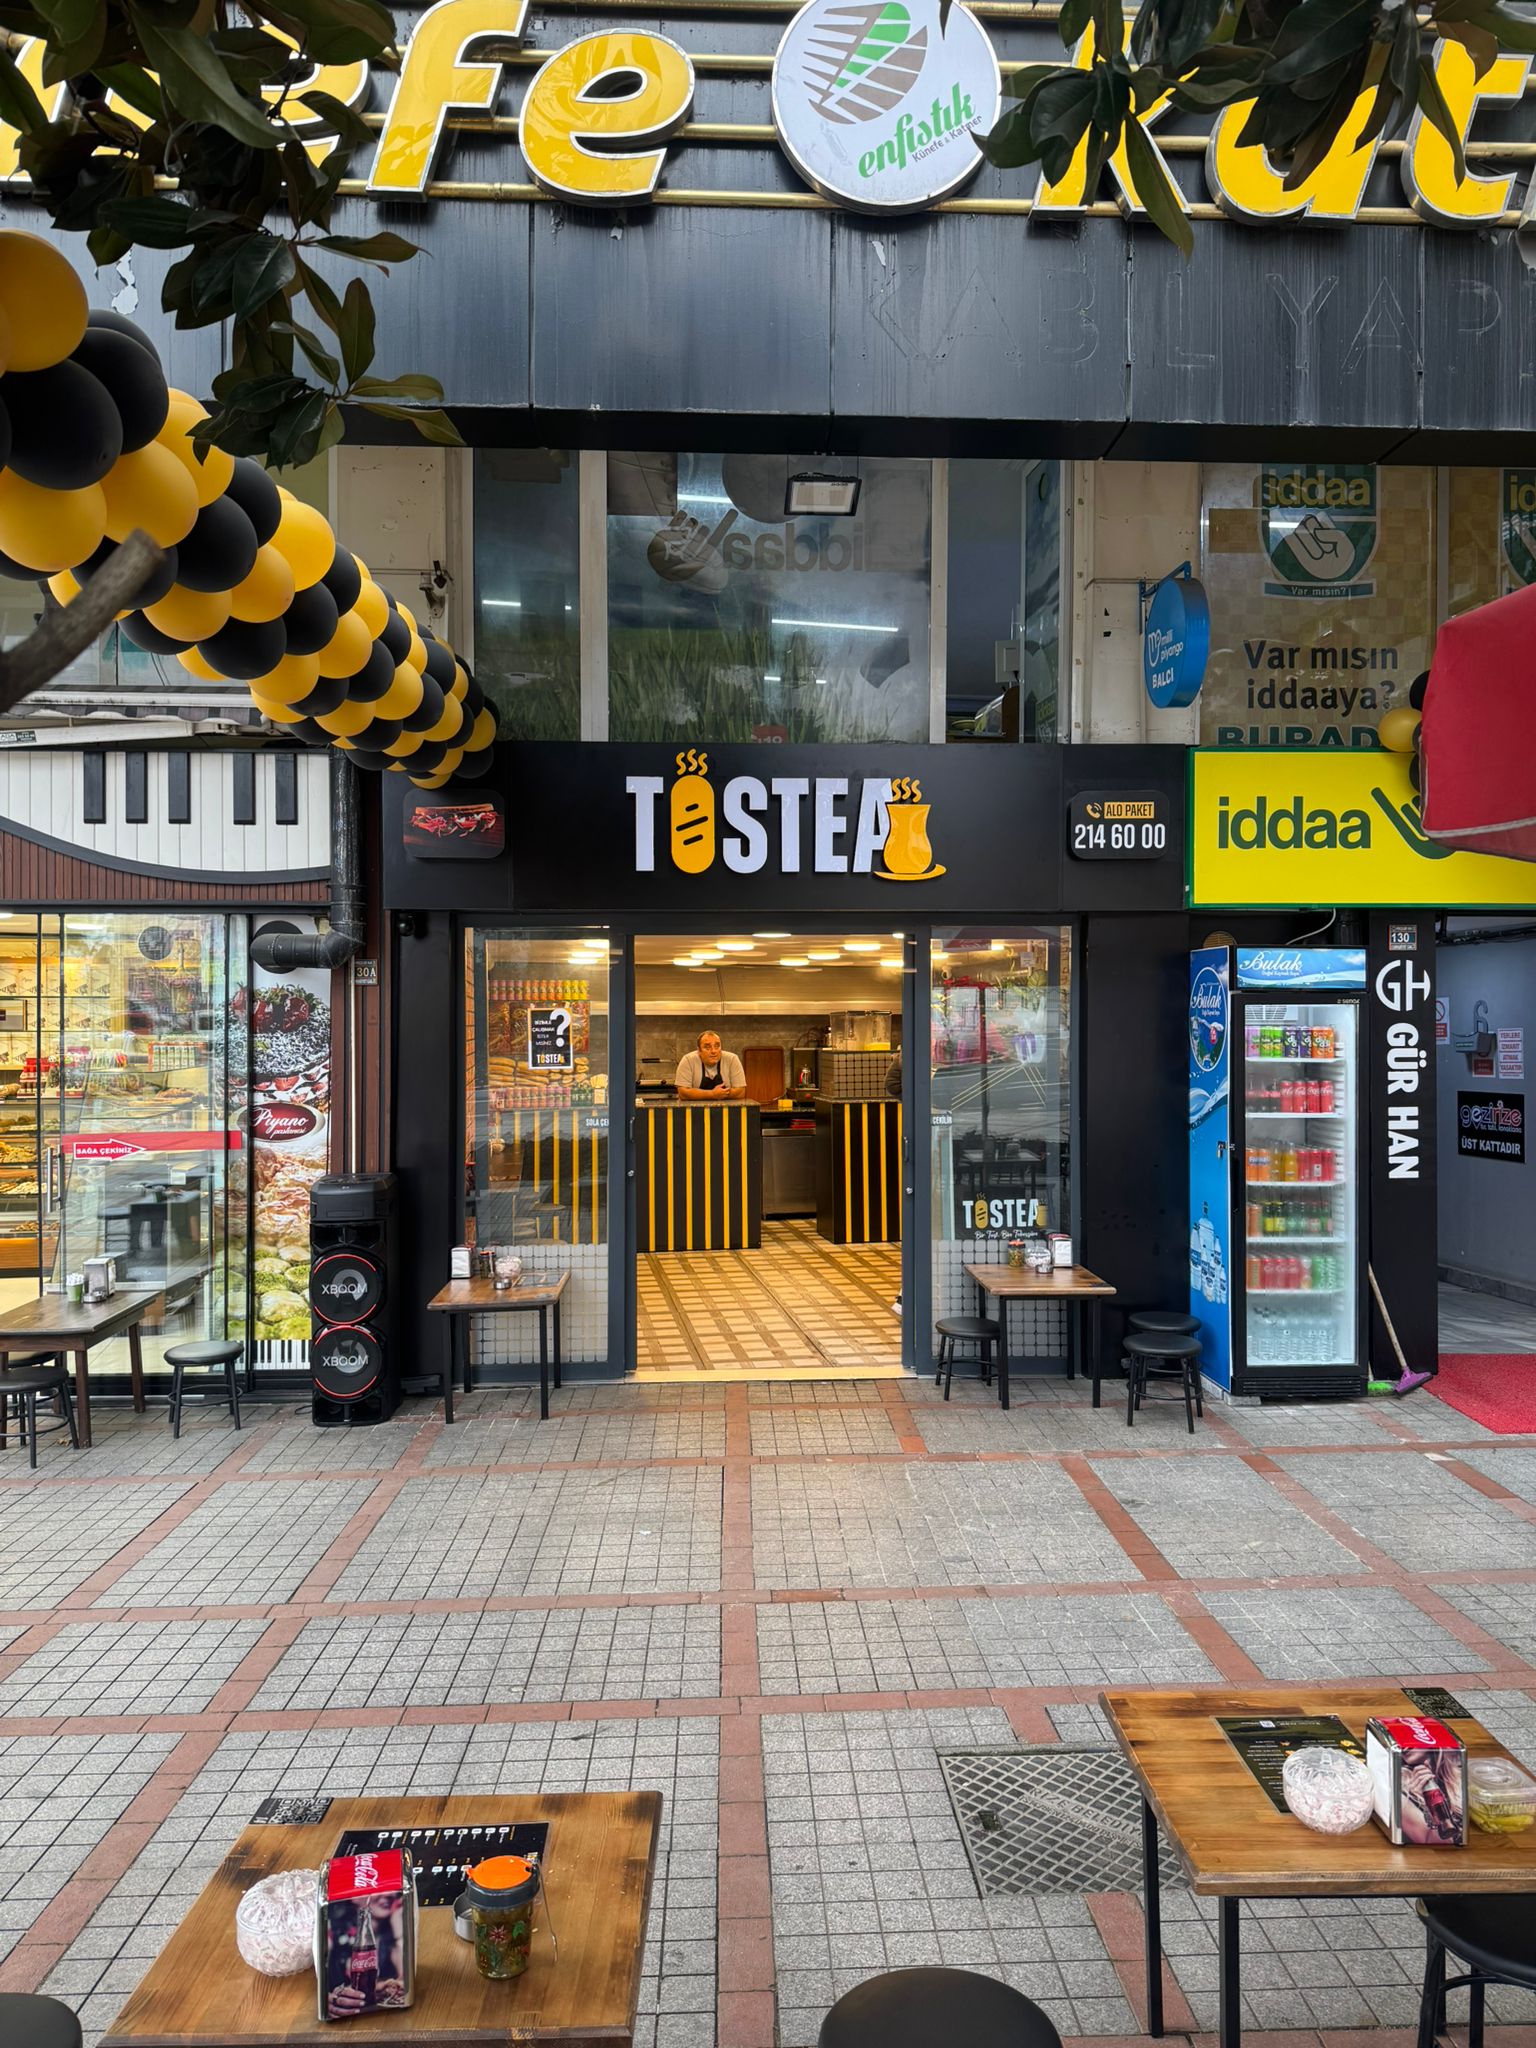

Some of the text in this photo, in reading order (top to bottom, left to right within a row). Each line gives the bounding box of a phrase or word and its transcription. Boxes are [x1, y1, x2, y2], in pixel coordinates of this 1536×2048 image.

[1244, 640, 1300, 669] Var
[1247, 678, 1396, 717] iddaaya?
[1106, 804, 1152, 816] ALO PAKET
[1218, 796, 1372, 849] iddaa
[1074, 823, 1166, 849] 214 60 00
[1391, 932, 1410, 943] 130
[1239, 951, 1303, 971] Bulak
[356, 966, 377, 977] 30A
[1386, 1022, 1427, 1179] GÜR HAN
[253, 1107, 308, 1134] Piyano
[1461, 1135, 1521, 1155] ÜST KATTADIR
[321, 1283, 368, 1295] XBOOM
[322, 1354, 369, 1367] XBOOM
